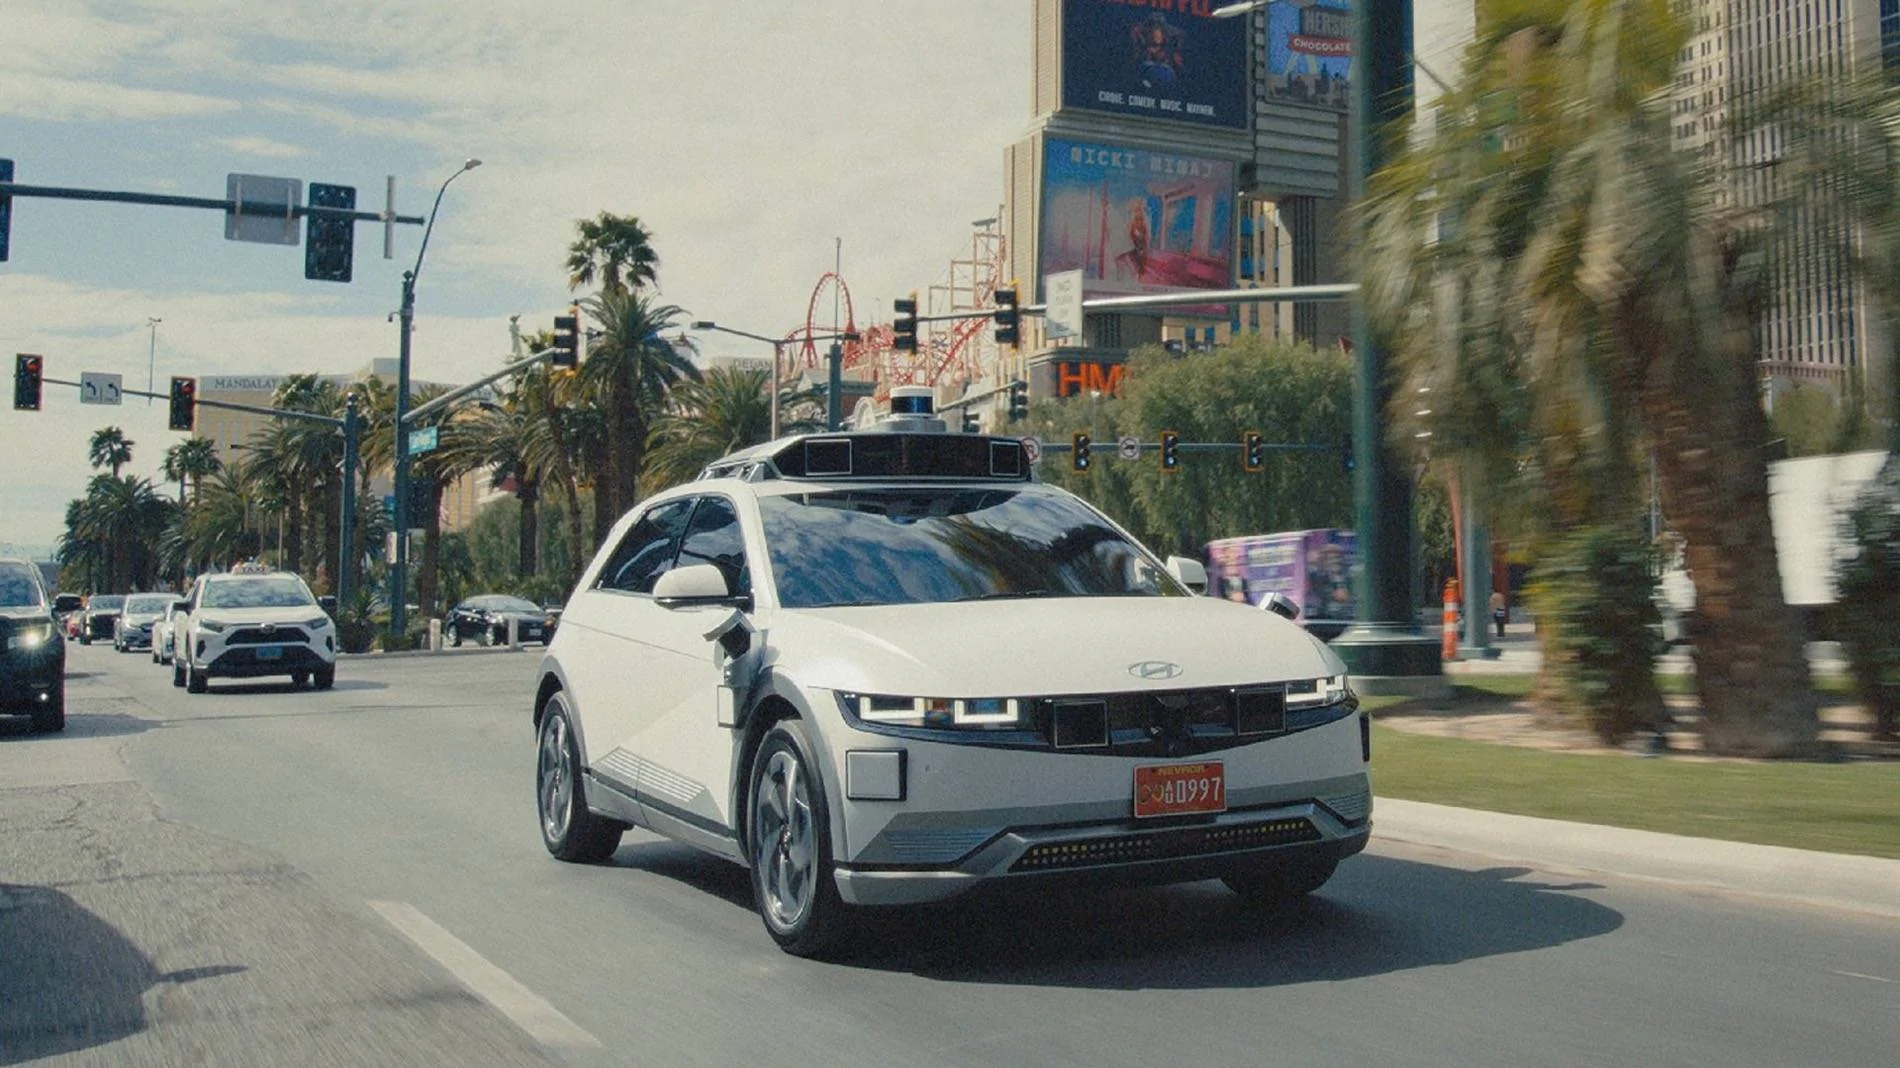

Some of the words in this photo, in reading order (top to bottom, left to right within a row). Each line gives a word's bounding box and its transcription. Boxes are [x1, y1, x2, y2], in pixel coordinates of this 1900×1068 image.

[1302, 9, 1352, 37] HERSH
[1294, 38, 1352, 51] CHOCOLATE
[1071, 147, 1136, 169] NICKI
[1150, 155, 1213, 178] MINAJ
[733, 358, 773, 369] DELAN
